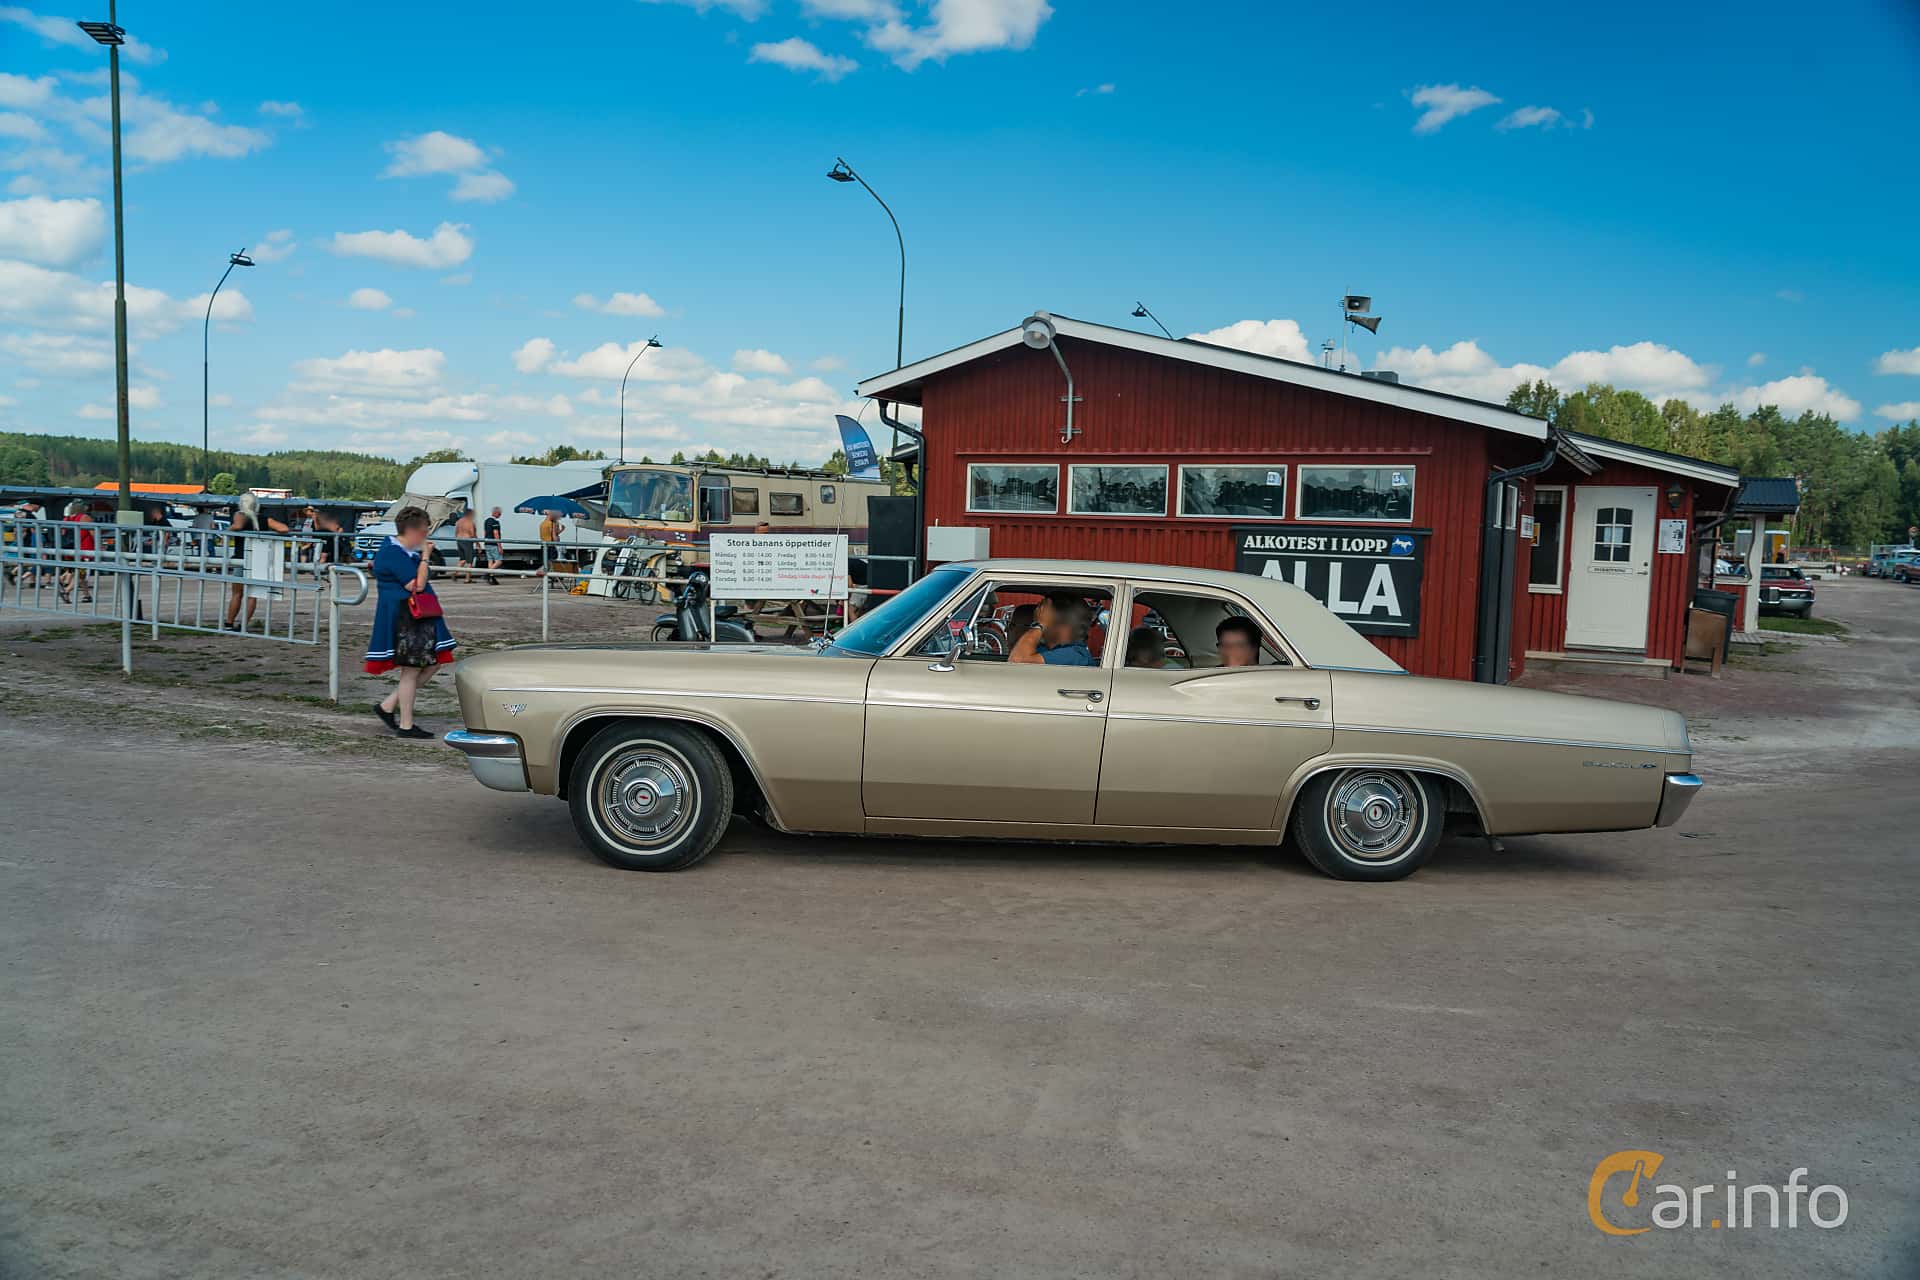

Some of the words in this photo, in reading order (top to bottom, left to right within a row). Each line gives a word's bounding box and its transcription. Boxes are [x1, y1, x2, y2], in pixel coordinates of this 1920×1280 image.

[727, 539, 750, 547] Stora
[752, 539, 783, 547] banans
[785, 539, 832, 549] öppettider
[1243, 535, 1328, 551] ALKOTEST
[1331, 537, 1339, 551] I
[1341, 537, 1388, 553] LOPP
